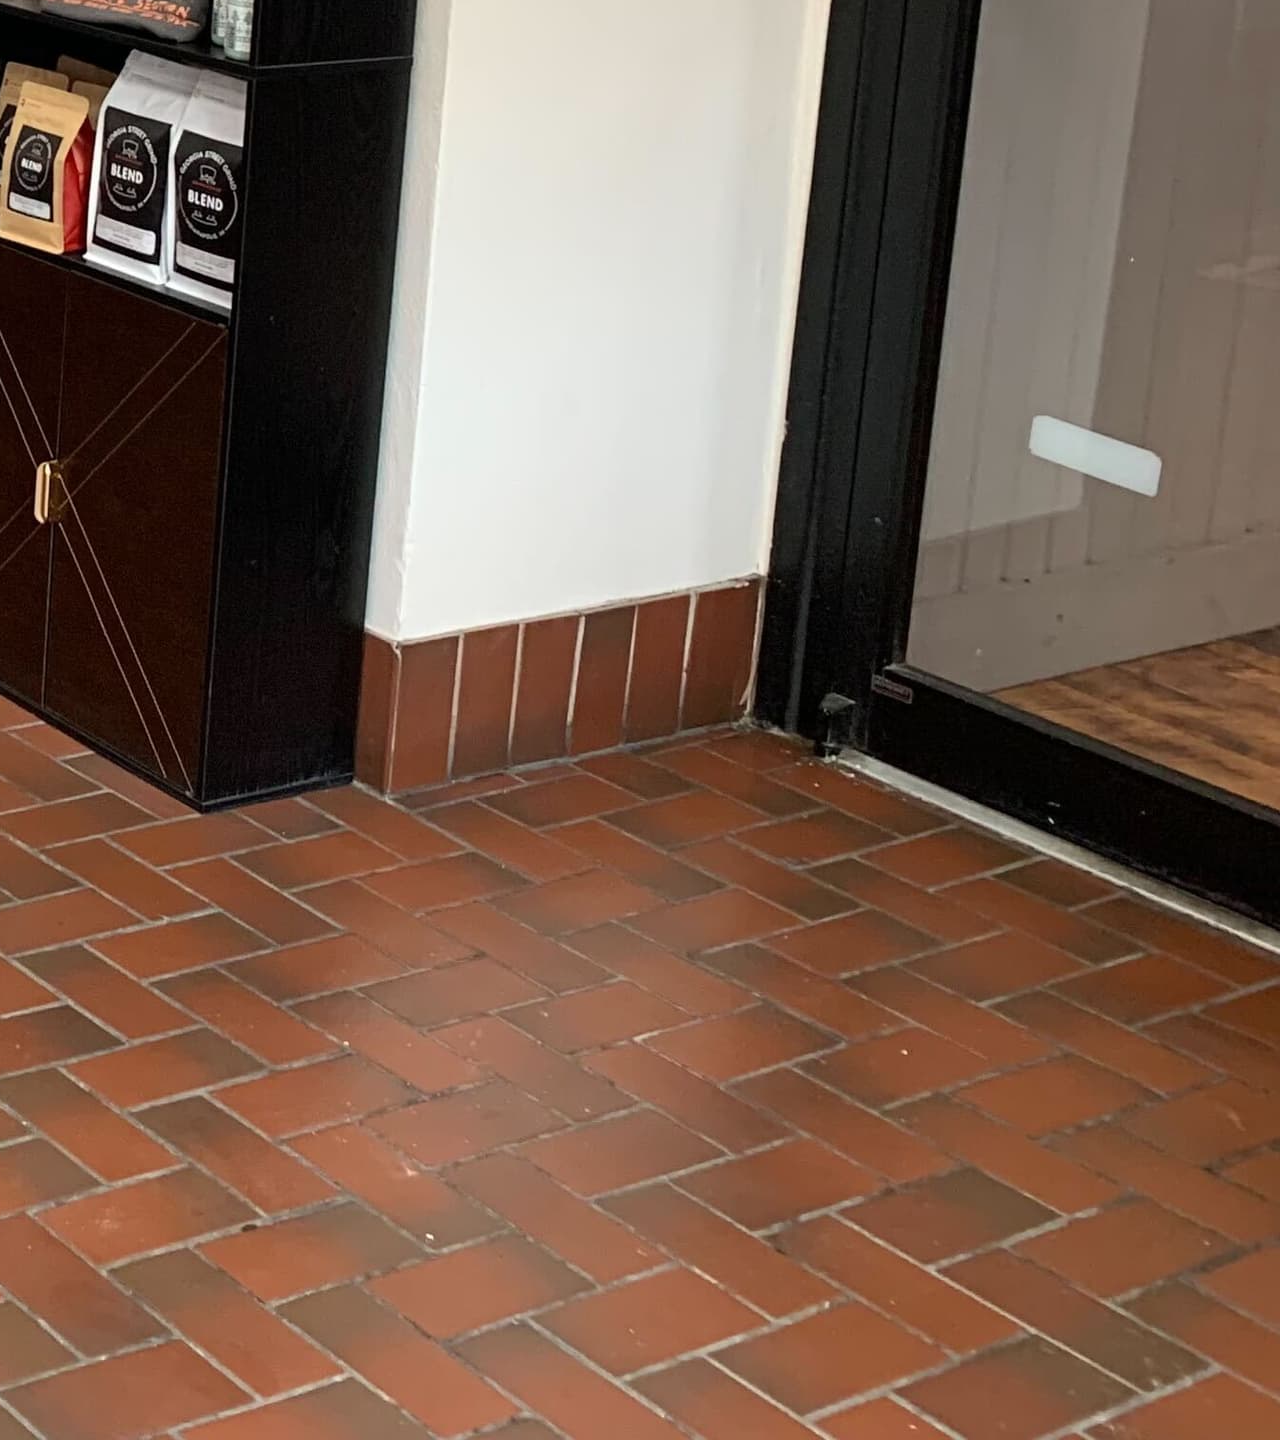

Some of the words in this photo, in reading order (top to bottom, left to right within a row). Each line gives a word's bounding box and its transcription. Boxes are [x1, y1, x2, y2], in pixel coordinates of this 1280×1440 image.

[20, 157, 43, 173] BLEND
[110, 162, 144, 185] BLEND
[187, 189, 224, 212] BLEND
